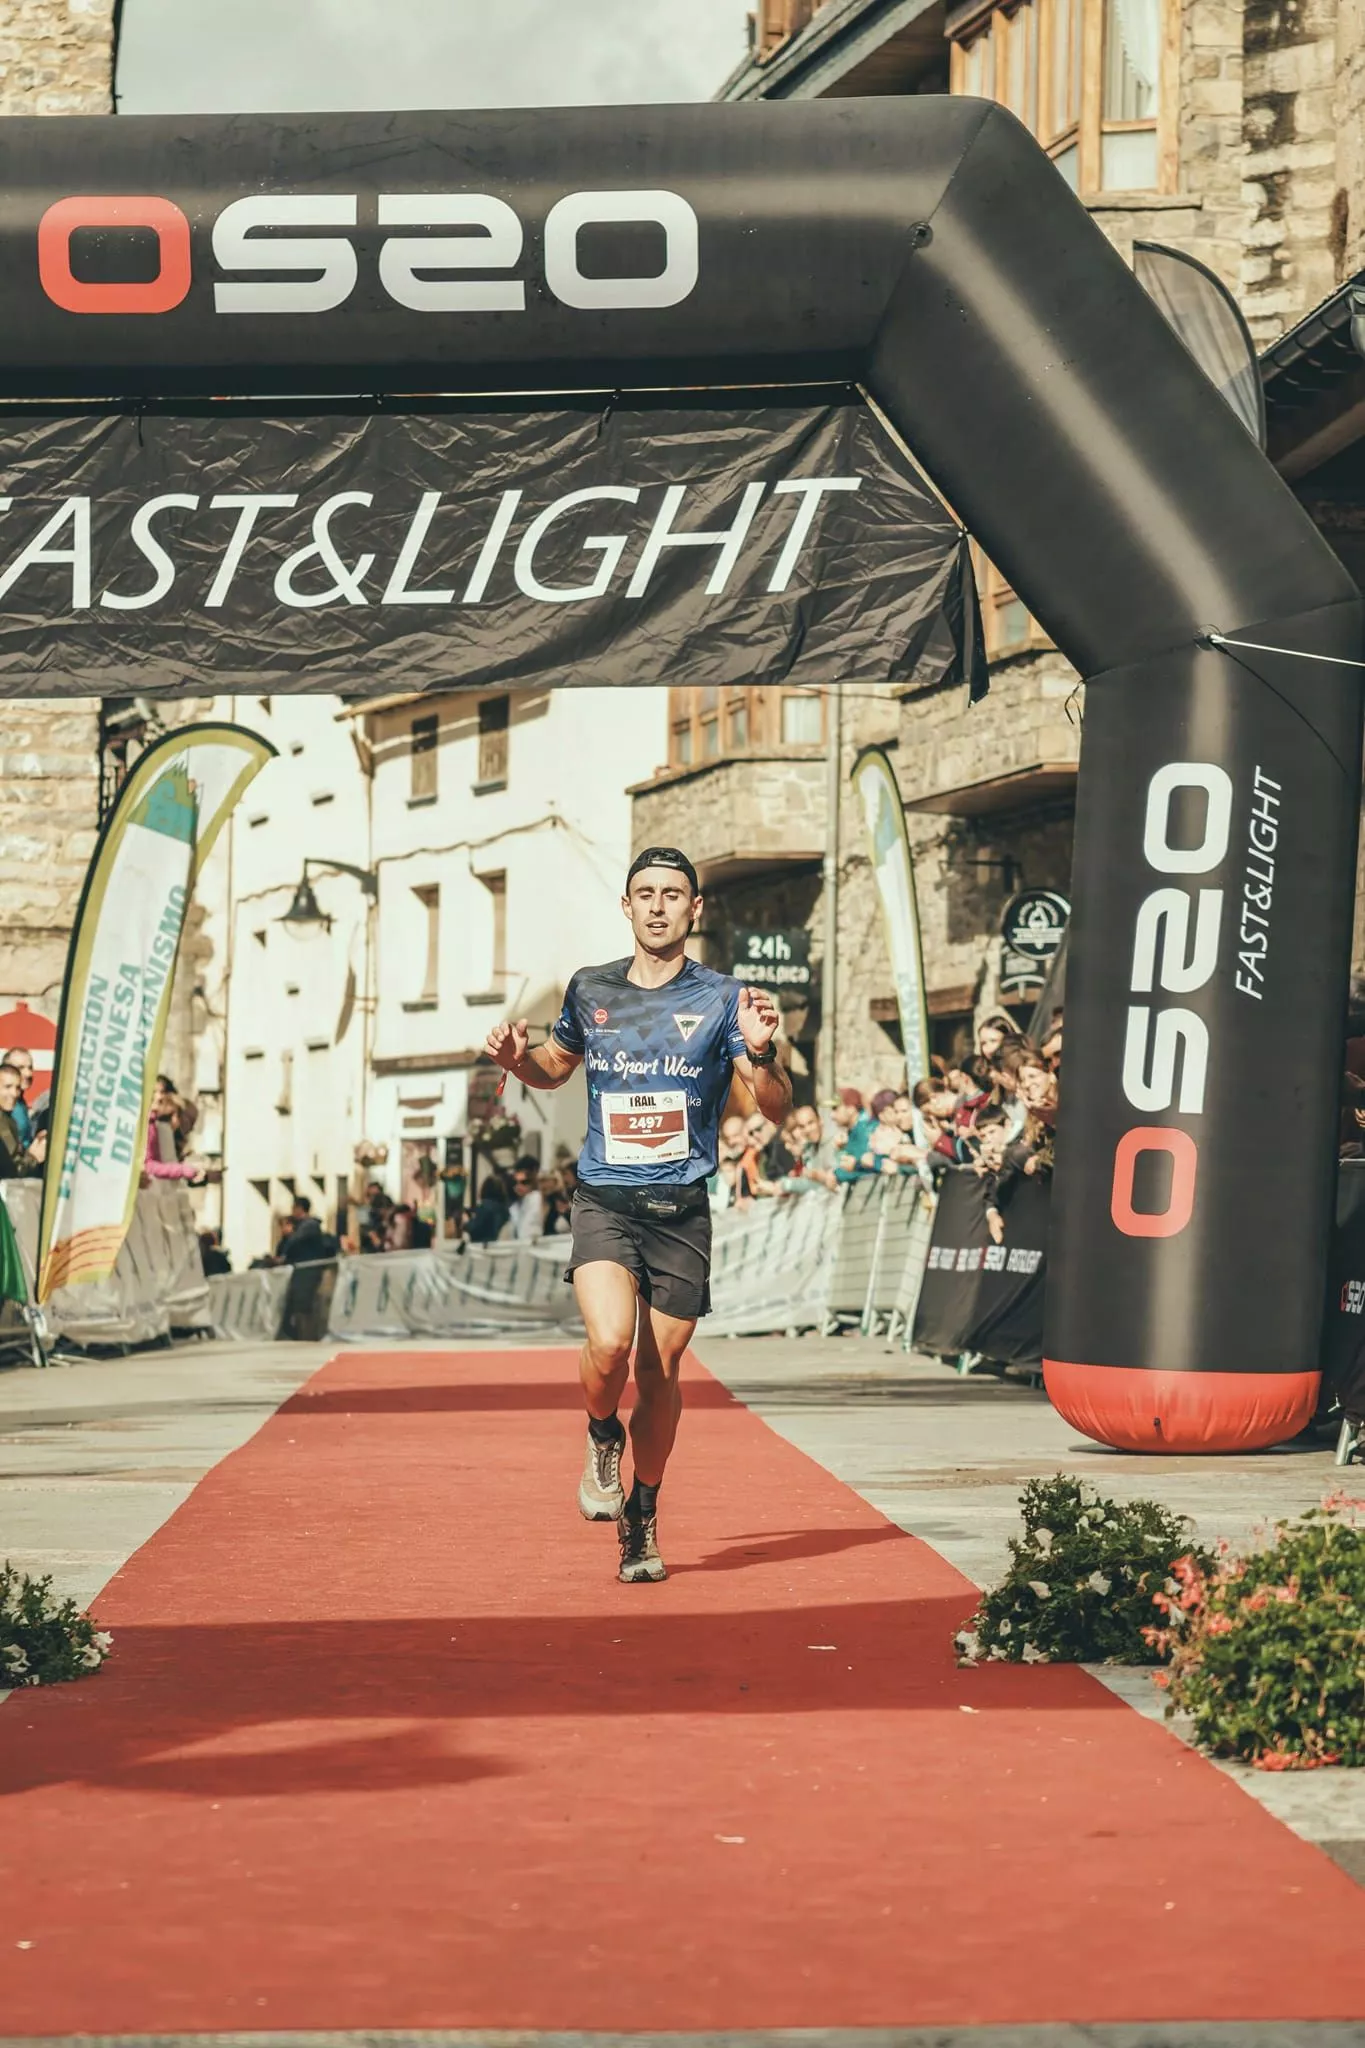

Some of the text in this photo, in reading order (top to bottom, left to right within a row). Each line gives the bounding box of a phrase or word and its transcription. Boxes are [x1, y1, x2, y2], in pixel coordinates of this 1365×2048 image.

[0, 475, 862, 610] AST&LIGHT
[1235, 765, 1282, 1000] FAST&LIGHT
[747, 934, 791, 961] 24h
[79, 962, 142, 1173] ARAGONESA
[613, 1050, 660, 1081] Sport
[663, 1055, 704, 1079] Wear
[630, 1095, 657, 1107] TRAIL
[687, 1095, 702, 1107] ika
[628, 1115, 664, 1130] 2497
[109, 1117, 136, 1166] DE
